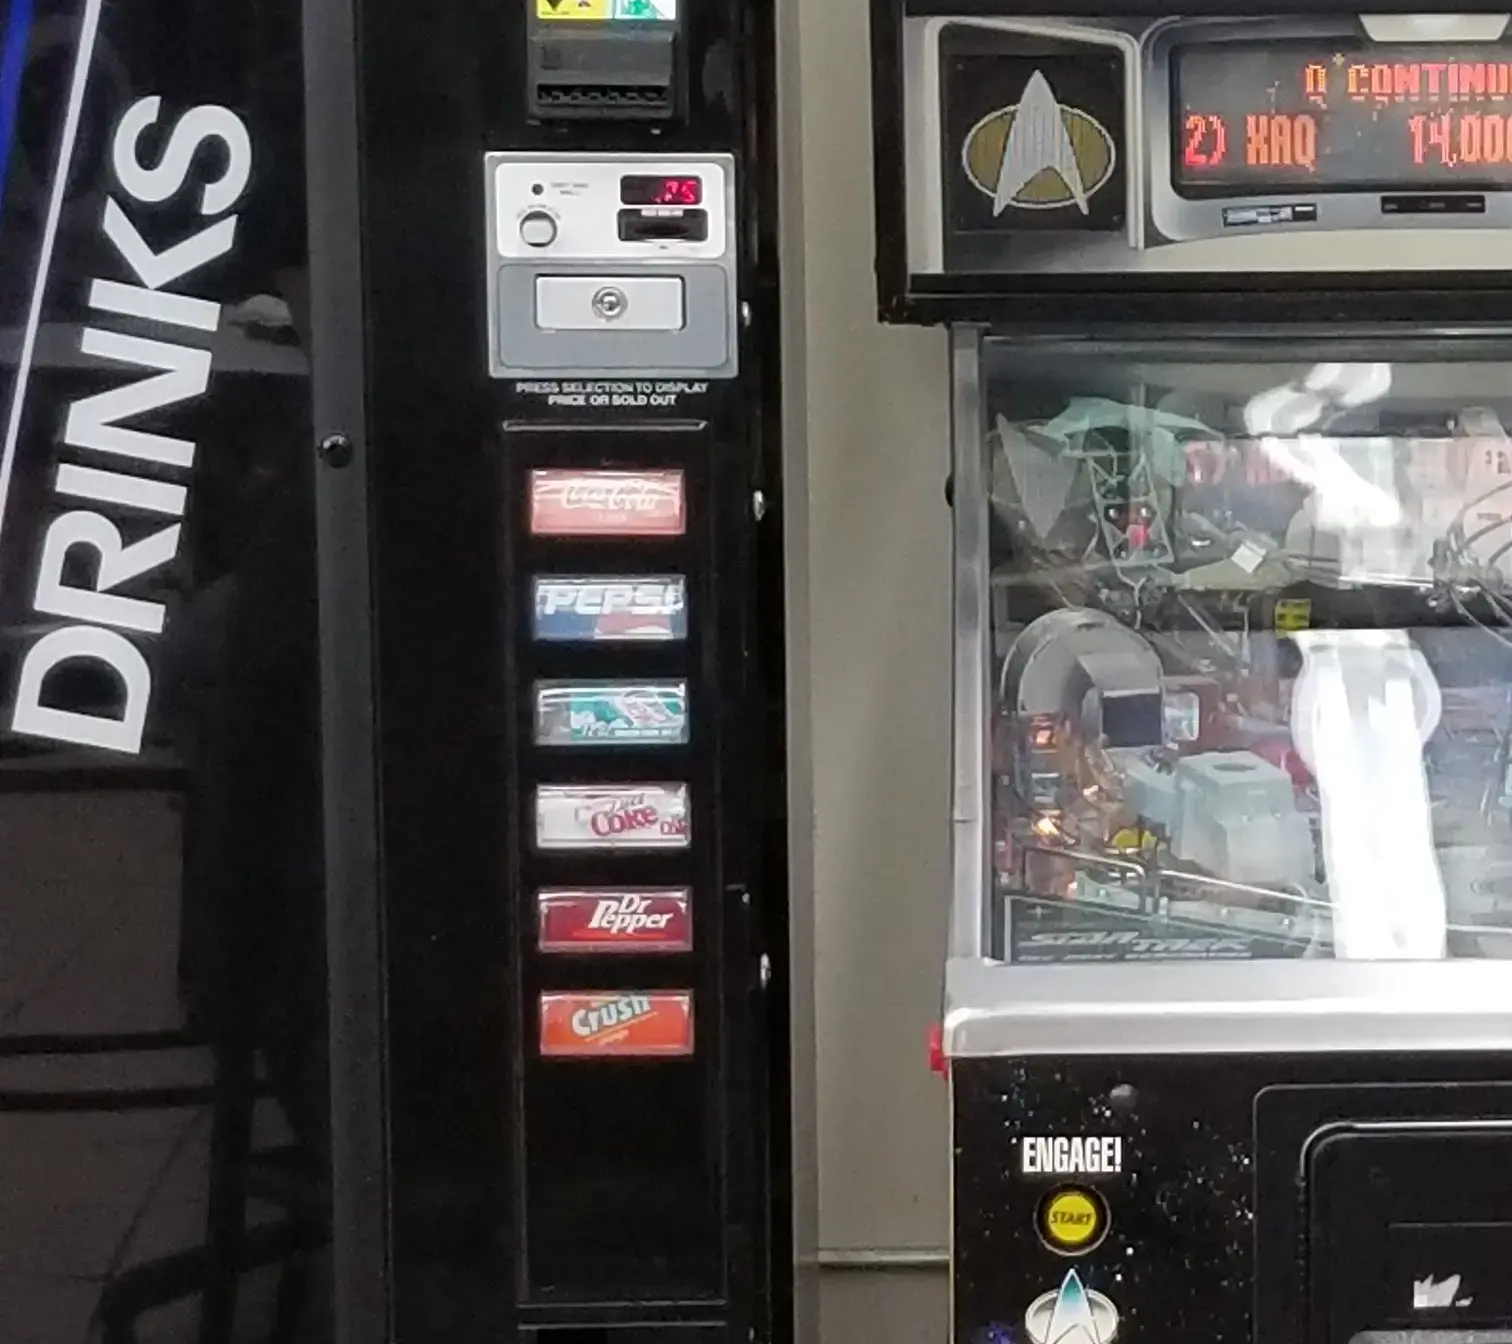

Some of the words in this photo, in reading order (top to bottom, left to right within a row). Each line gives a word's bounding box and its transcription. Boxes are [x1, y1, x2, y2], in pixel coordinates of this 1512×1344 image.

[650, 394, 677, 405] OUT
[12, 96, 252, 754] DRINKS
[588, 900, 674, 934] Pepper
[619, 895, 652, 914] Dr
[572, 995, 653, 1037] Crush
[1022, 1136, 1122, 1173] ENGAGE!
[1051, 1211, 1092, 1226] START
